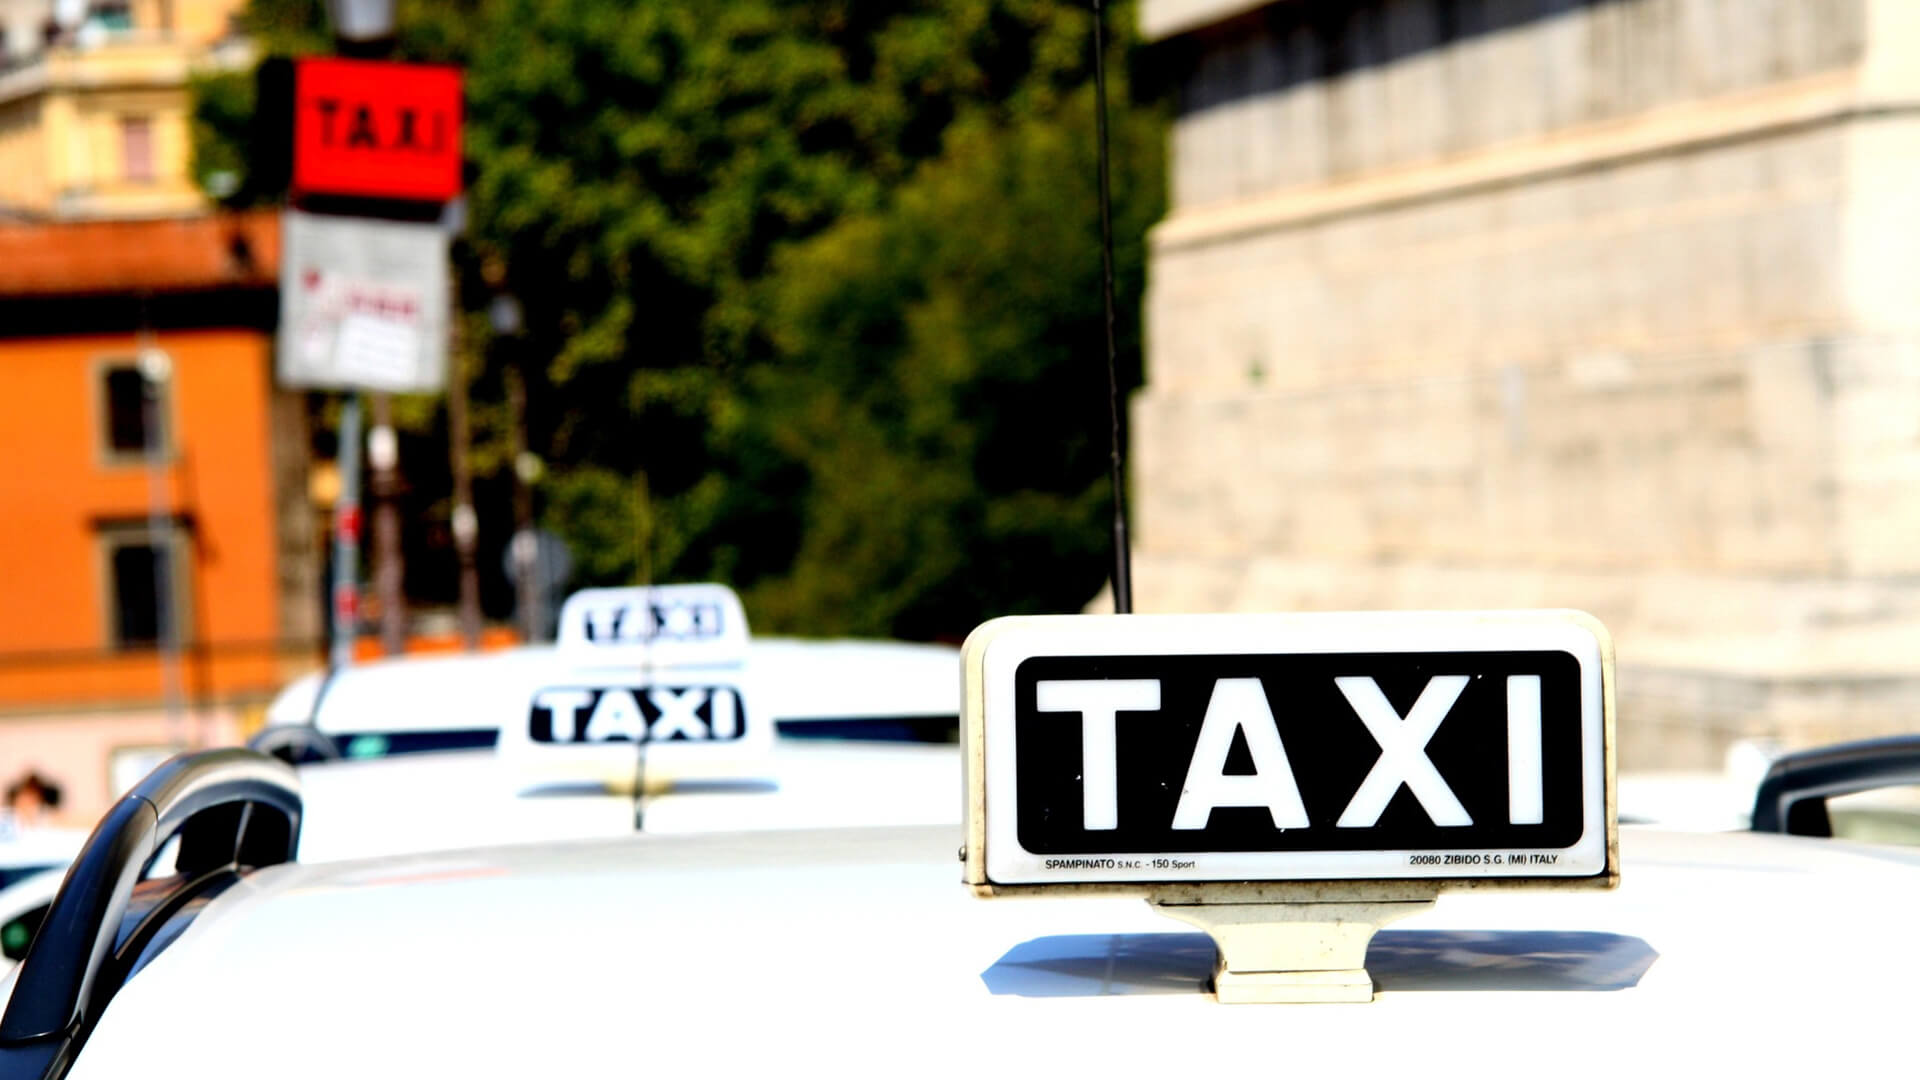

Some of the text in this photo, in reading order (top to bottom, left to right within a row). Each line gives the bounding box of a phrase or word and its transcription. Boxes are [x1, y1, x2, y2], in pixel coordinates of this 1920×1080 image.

[317, 98, 446, 153] TAXI
[535, 687, 736, 742] TAXI
[1036, 674, 1544, 830] TAXI
[1045, 859, 1115, 869] SPAMPINATO
[1152, 859, 1169, 868] 150
[1171, 860, 1196, 869] Sport
[1409, 854, 1559, 865] 20080 ZIBIDO S.G. (MI) ITALY
